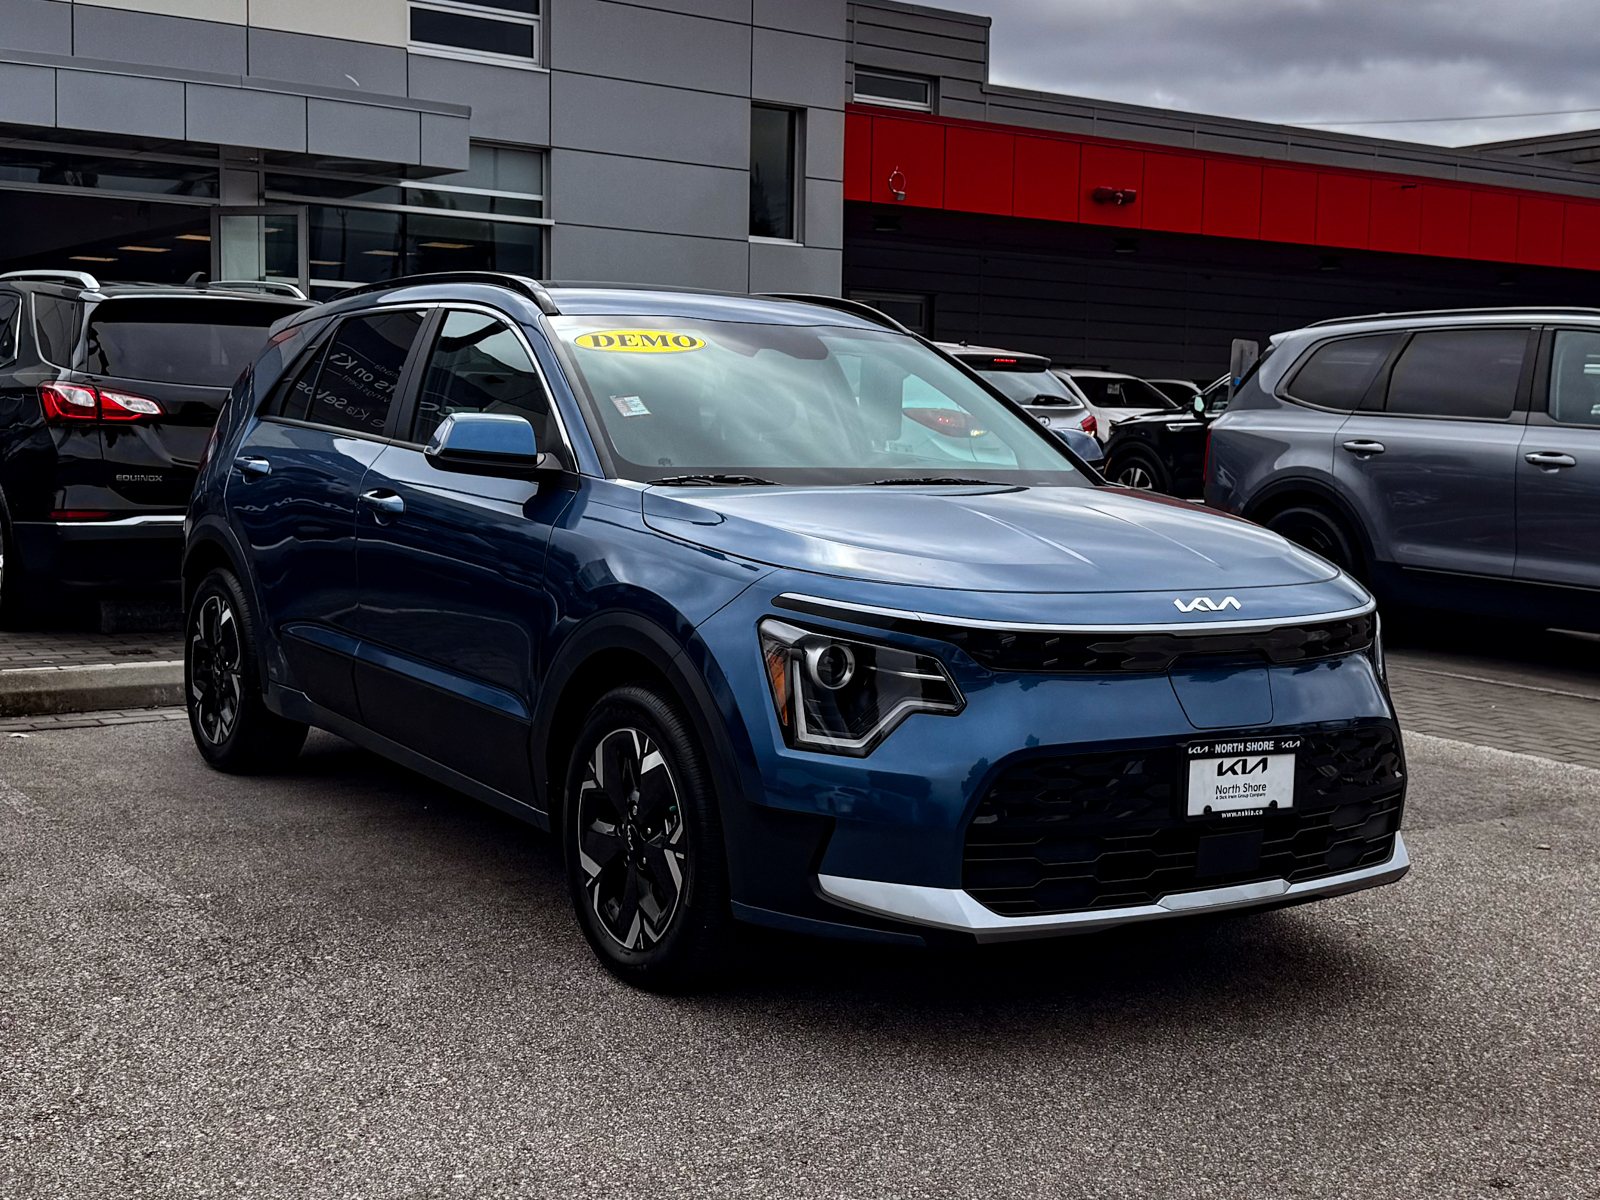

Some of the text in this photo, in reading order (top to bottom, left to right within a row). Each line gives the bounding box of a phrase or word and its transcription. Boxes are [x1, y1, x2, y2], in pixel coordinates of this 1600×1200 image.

[591, 334, 698, 348] DEMO
[116, 474, 163, 482] EQUINOX
[1173, 596, 1242, 613] KIA
[1214, 742, 1244, 754] NORTH
[1246, 740, 1275, 752] SHORE
[1217, 757, 1268, 777] KIA
[1215, 782, 1267, 795] North Shore
